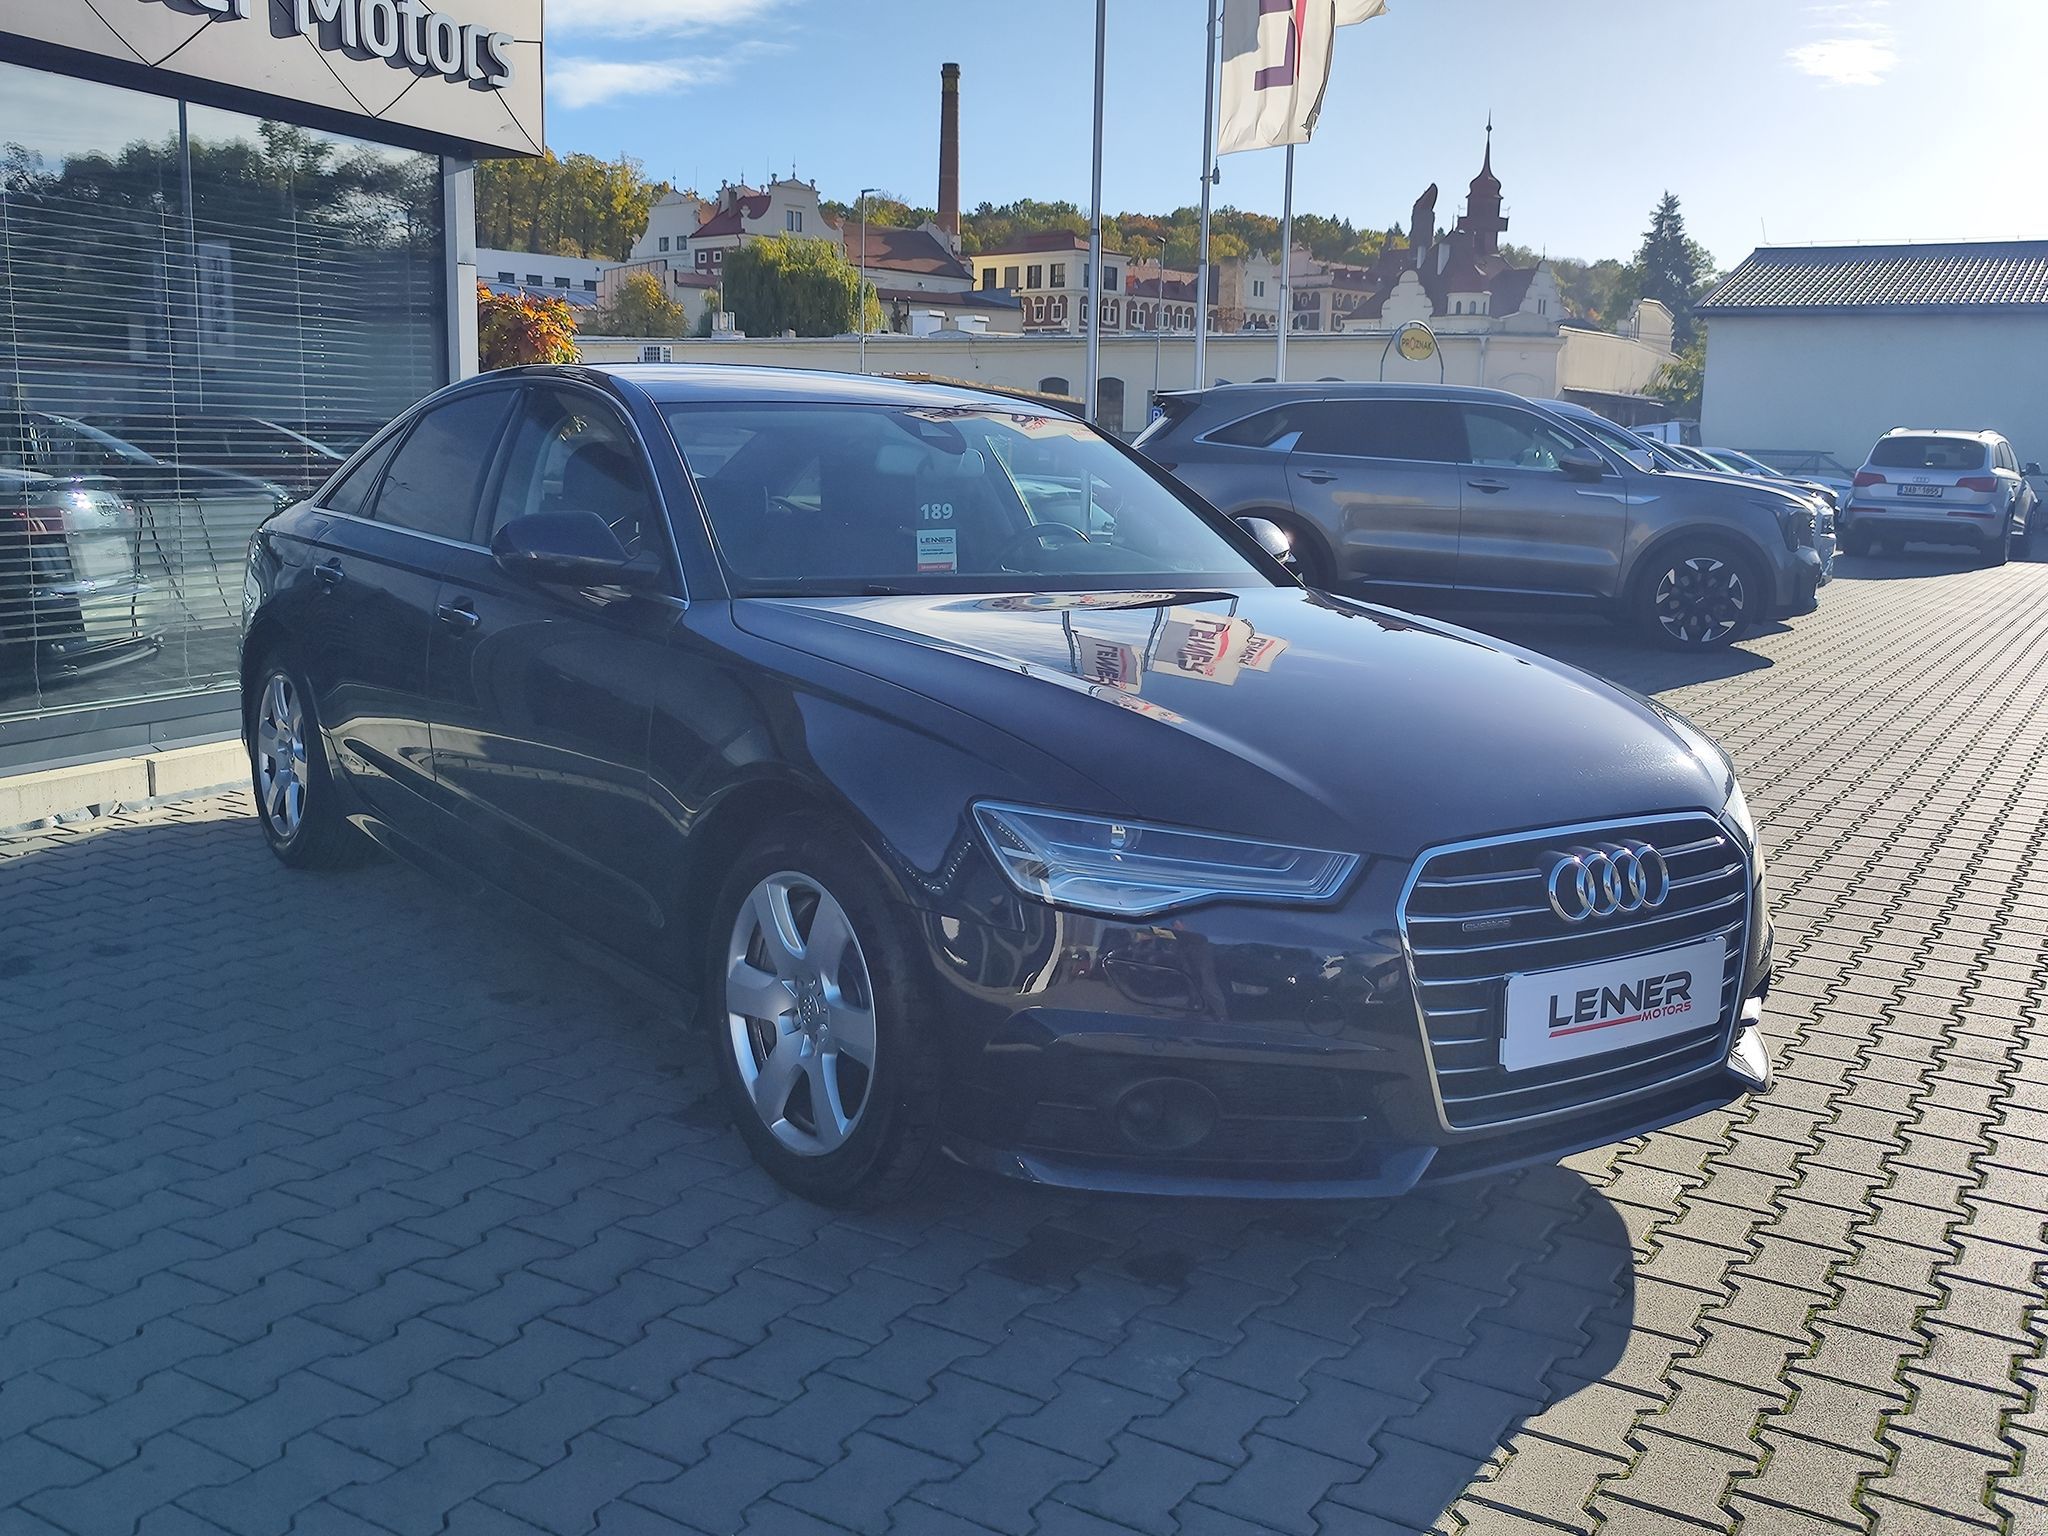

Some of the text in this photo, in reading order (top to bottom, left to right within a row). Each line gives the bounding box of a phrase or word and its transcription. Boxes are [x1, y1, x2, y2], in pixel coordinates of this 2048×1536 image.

[295, 0, 516, 88] Motors
[920, 503, 953, 520] 189
[1549, 970, 1692, 1029] LENNER
[1641, 1001, 1692, 1022] MOTORS
